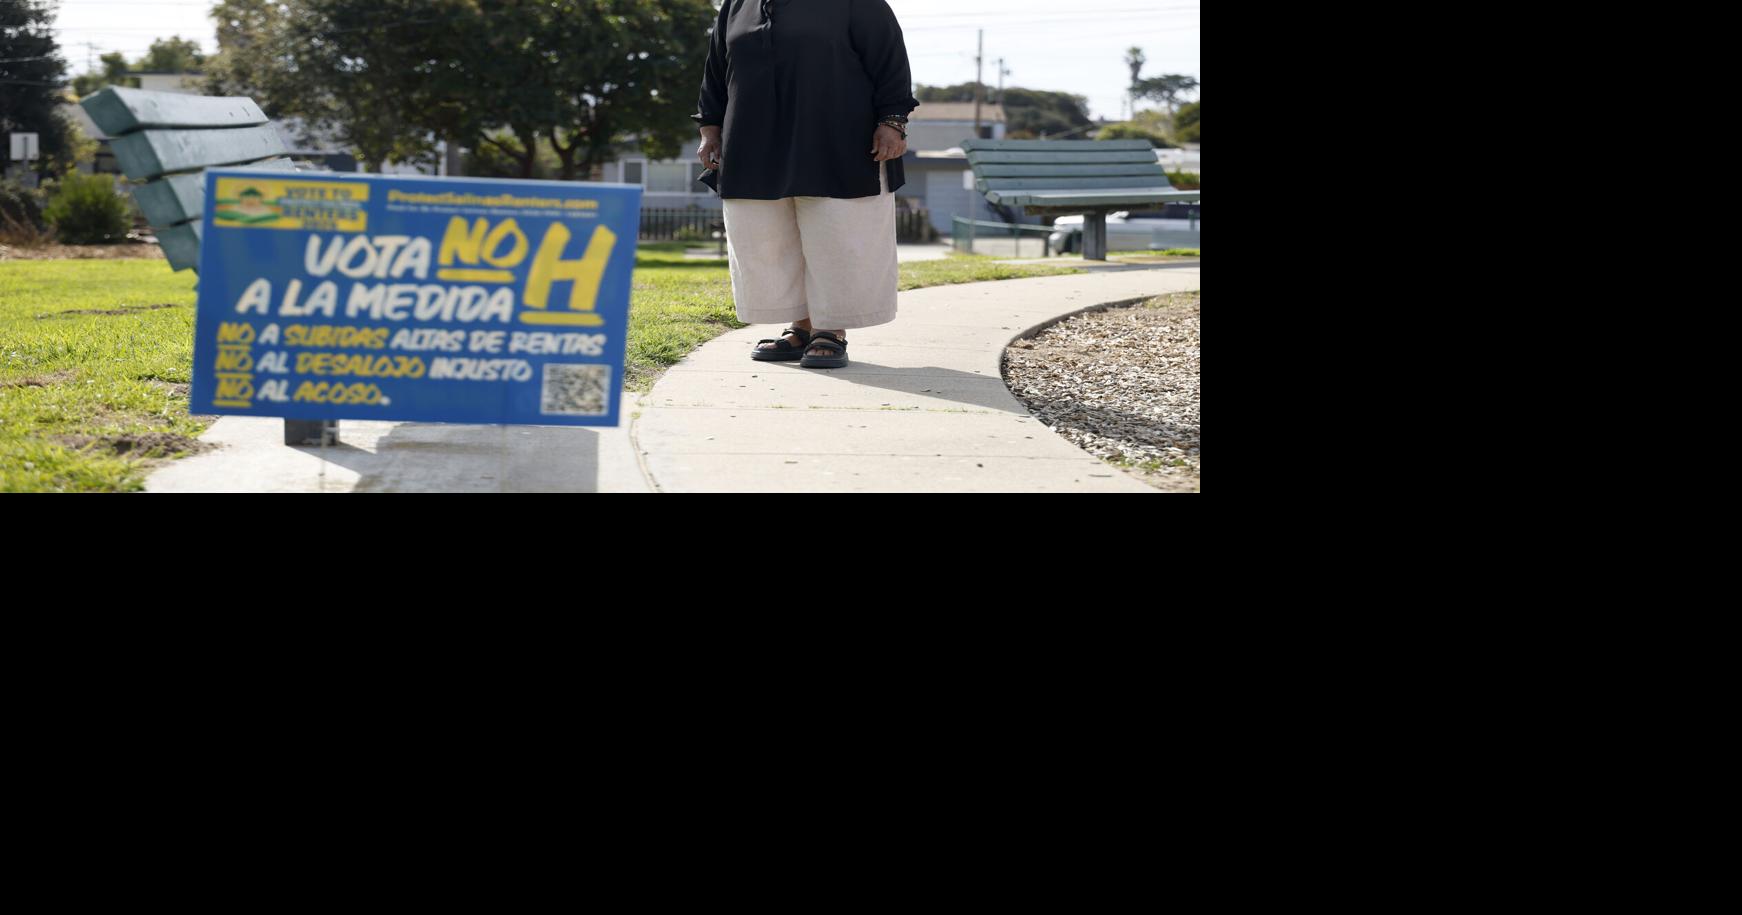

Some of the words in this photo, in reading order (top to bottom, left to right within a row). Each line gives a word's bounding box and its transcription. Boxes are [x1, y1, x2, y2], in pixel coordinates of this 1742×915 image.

[304, 234, 431, 279] VOTA
[437, 216, 528, 268] NO
[235, 278, 271, 314] A
[278, 280, 338, 317] LA
[345, 283, 514, 323] MEDIDA
[523, 221, 618, 311] H
[217, 322, 255, 344] NO
[258, 324, 280, 345] A
[284, 325, 389, 348] SUBIDAS
[390, 328, 464, 351] ALTAS
[469, 331, 502, 351] DE
[509, 331, 606, 356] RENTAS
[215, 350, 253, 373] NO
[256, 351, 290, 374] AL
[294, 353, 426, 379] DESALOJO
[429, 358, 532, 381] INJUSTO
[217, 379, 253, 400] NO
[257, 380, 290, 401] AL
[293, 381, 392, 405] ACOSO.
